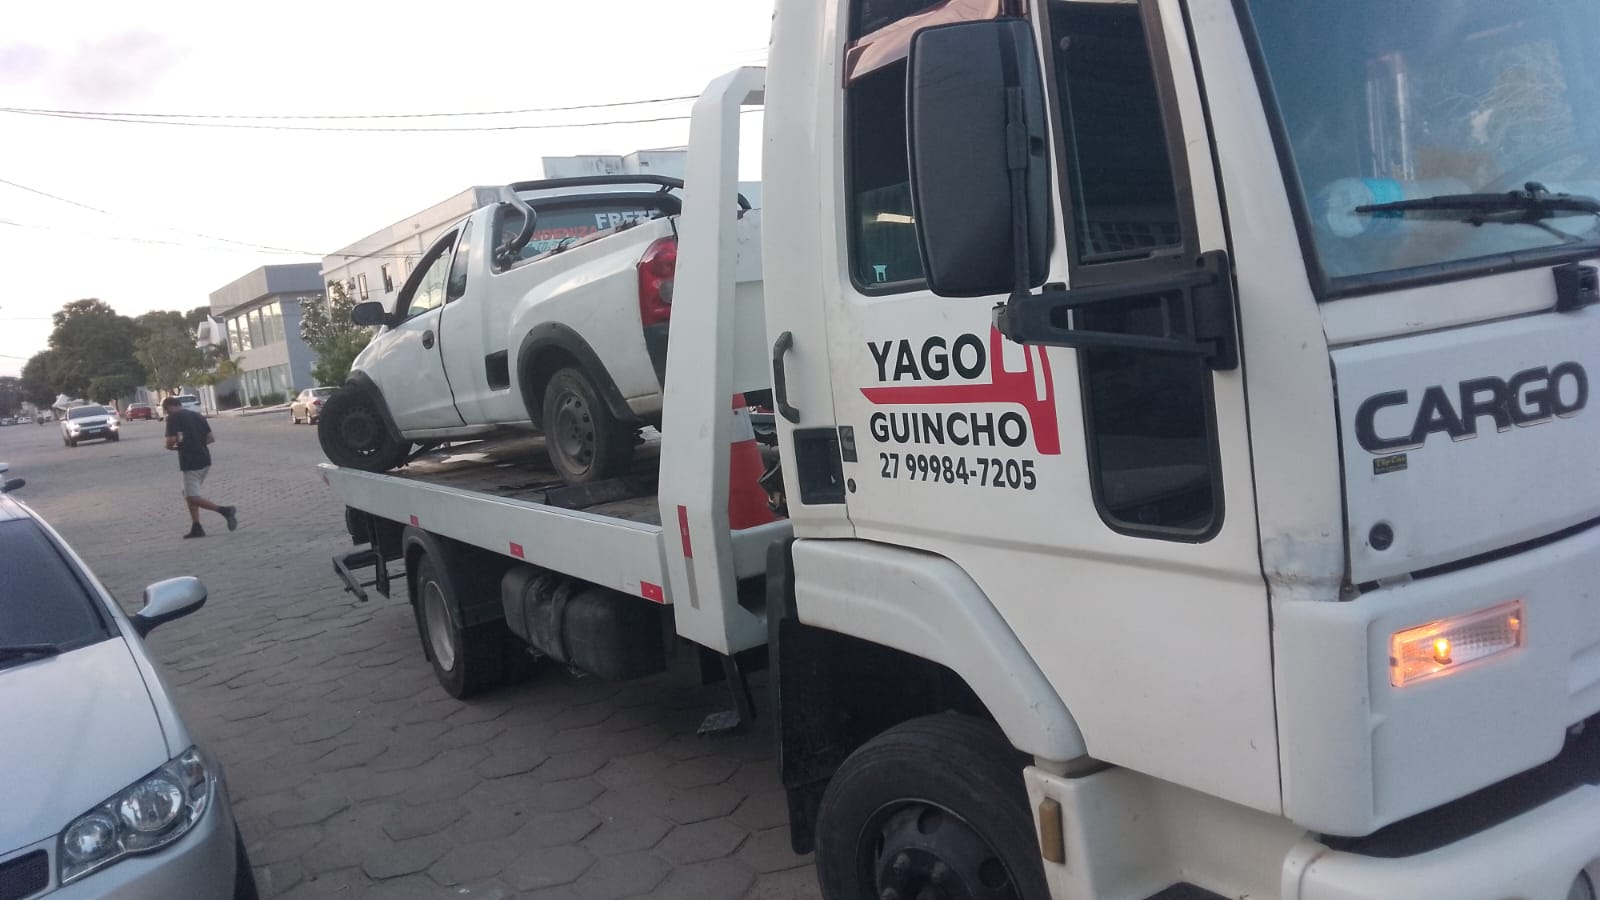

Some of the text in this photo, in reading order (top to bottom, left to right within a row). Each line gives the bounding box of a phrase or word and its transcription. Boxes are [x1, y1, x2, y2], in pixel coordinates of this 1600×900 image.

[867, 333, 986, 382] YAGO
[870, 412, 1028, 447] GUINCHO
[1355, 361, 1589, 455] CARGO
[879, 452, 1037, 491] 27 99984-7205
